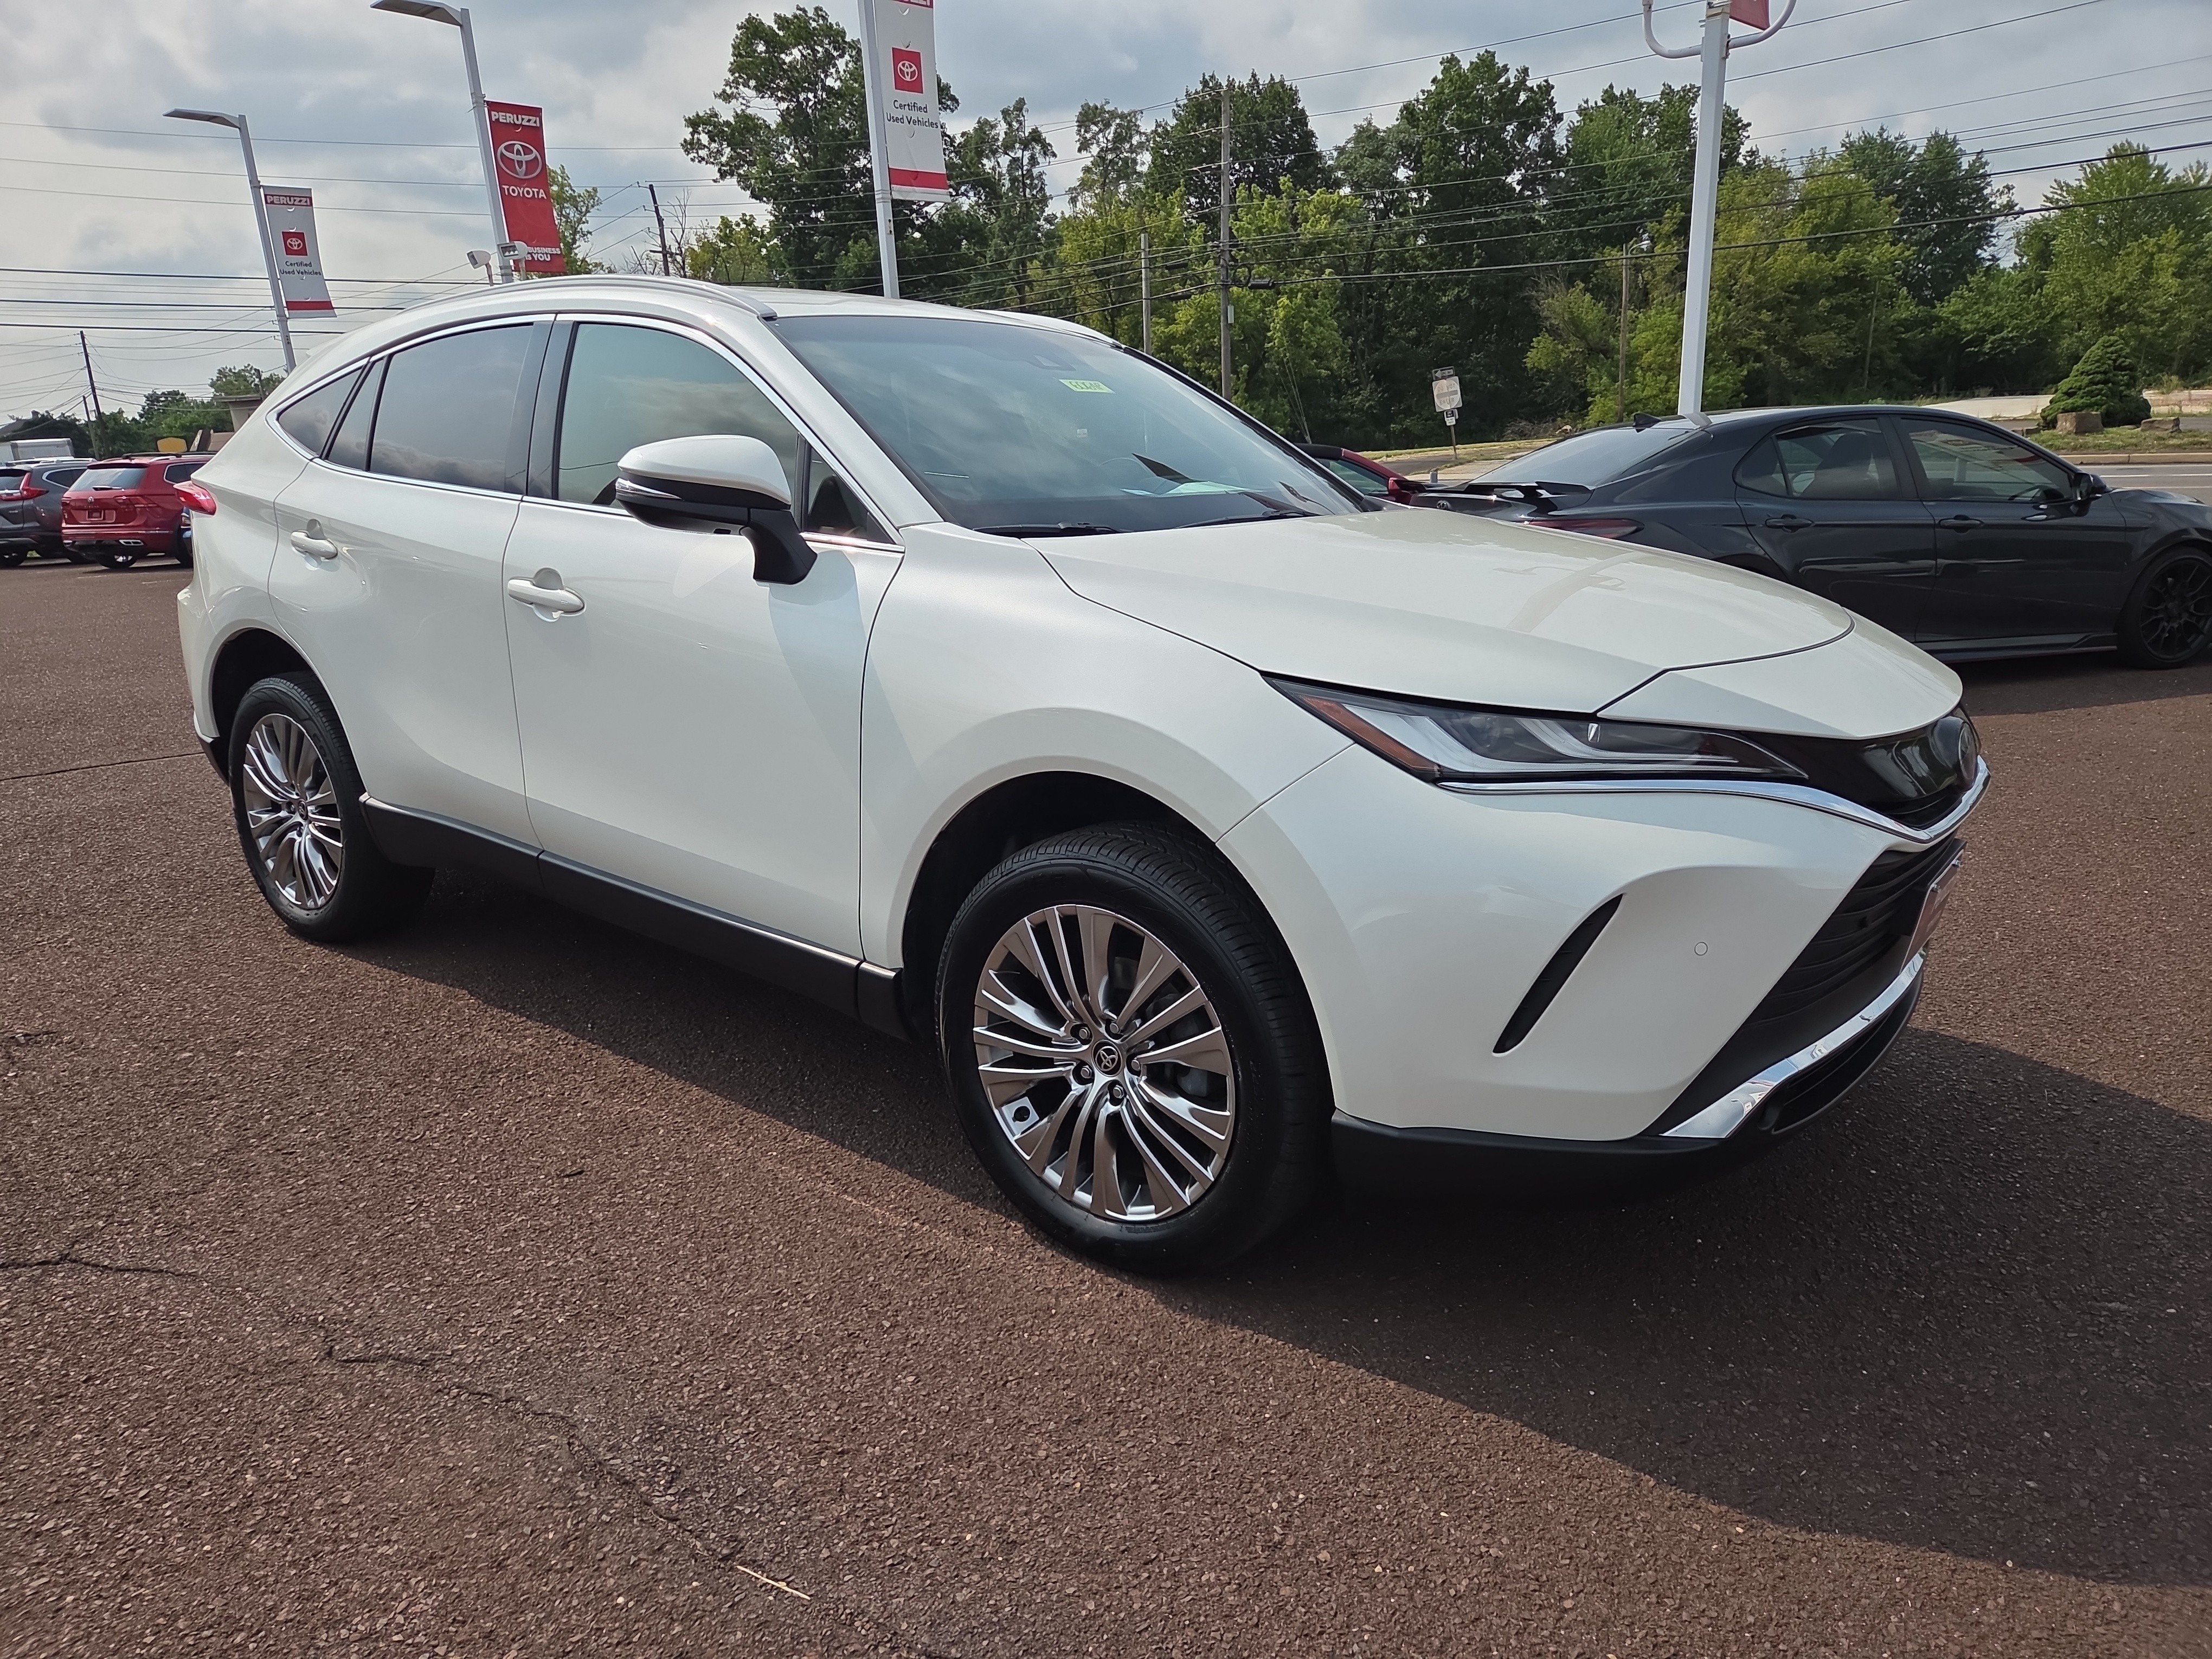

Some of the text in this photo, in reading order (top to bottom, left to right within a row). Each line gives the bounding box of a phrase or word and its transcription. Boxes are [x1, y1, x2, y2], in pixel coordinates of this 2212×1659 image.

[893, 100, 928, 113] Certified
[491, 111, 540, 127] PERUZZI
[886, 112, 938, 129] Used Vehicles
[502, 185, 547, 200] TOYOTA
[266, 195, 310, 205] PERUZZI
[532, 253, 551, 261] YOU
